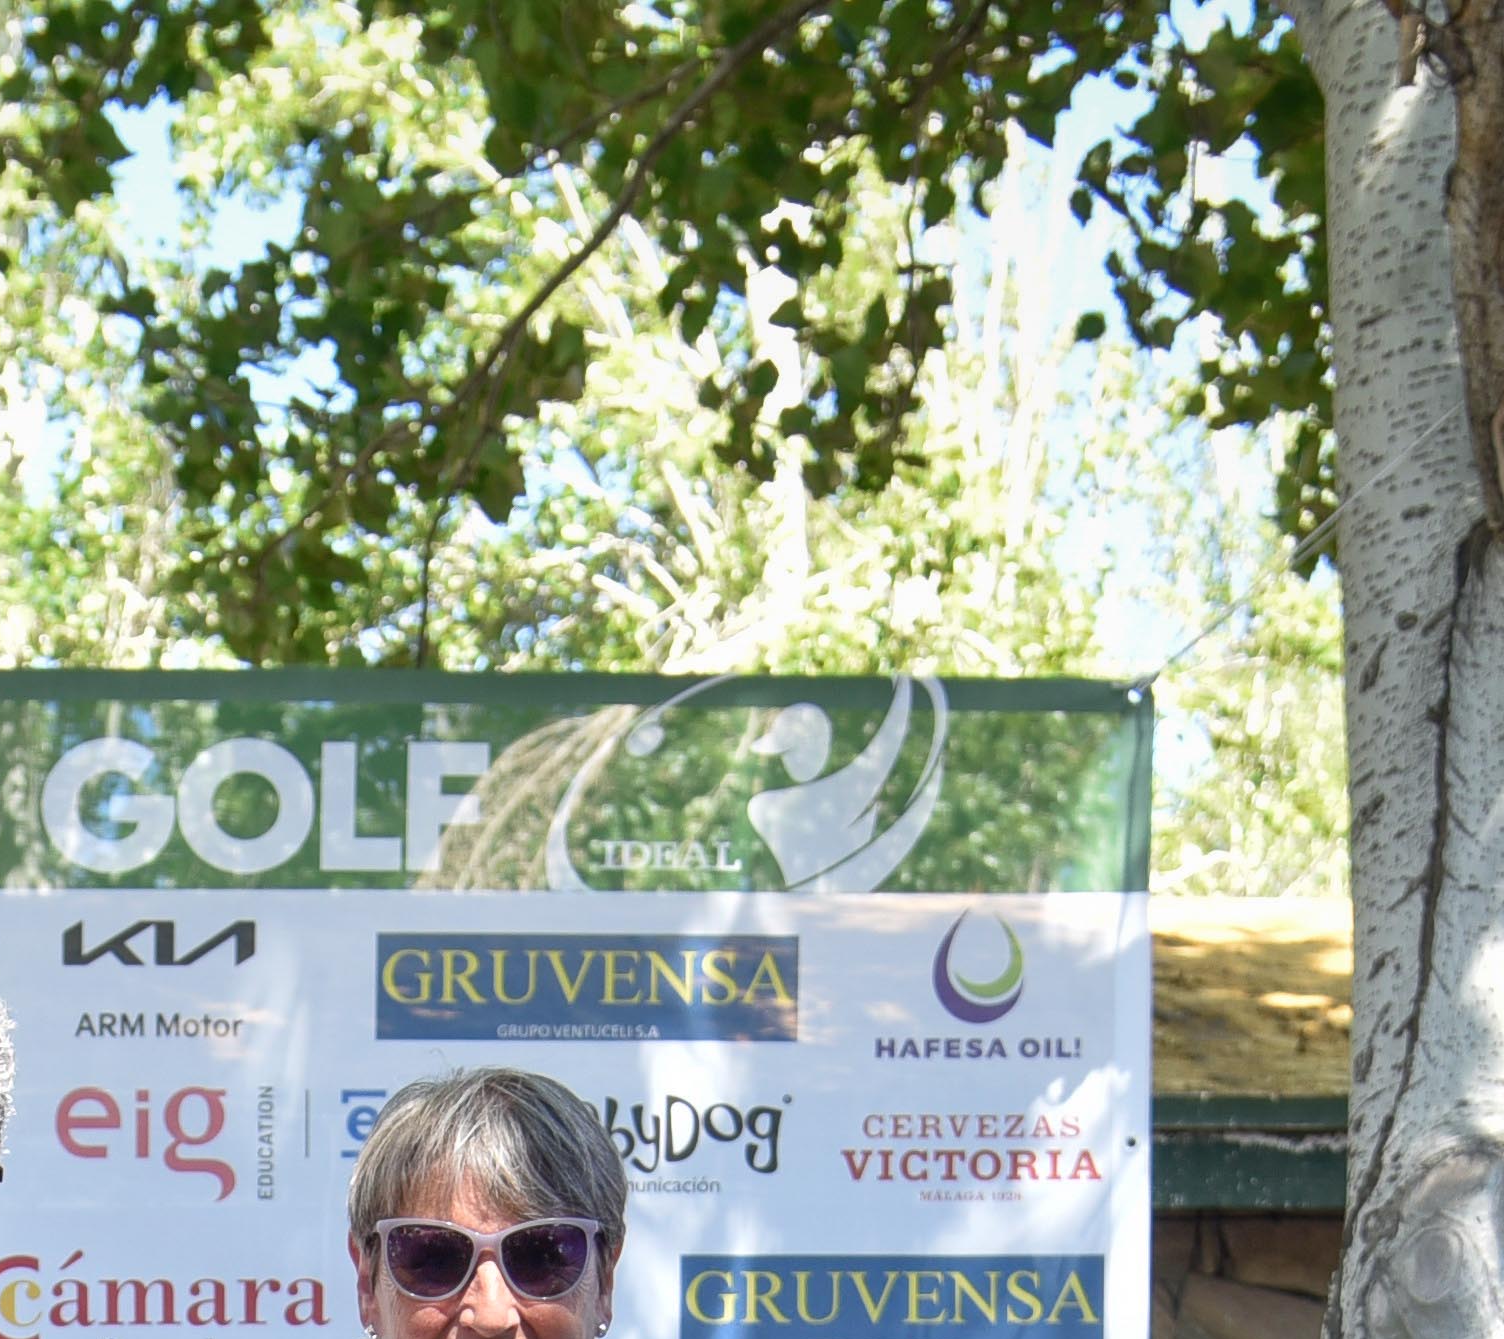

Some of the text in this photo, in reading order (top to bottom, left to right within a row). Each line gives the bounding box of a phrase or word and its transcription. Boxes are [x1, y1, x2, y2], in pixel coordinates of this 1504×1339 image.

[41, 736, 490, 875] GOLF
[597, 840, 742, 873] IDEAL
[62, 919, 256, 966] KIA
[381, 948, 793, 1006] GRUVENSA
[75, 1012, 242, 1039] ARM Motor
[496, 1023, 552, 1039] GRUPO
[874, 1037, 1082, 1059] HAFESA OIL!
[55, 1086, 237, 1202] eig
[256, 1085, 275, 1200] EDUCATION
[584, 1095, 783, 1174] byDog
[862, 1114, 1082, 1139] CERVEZAS
[841, 1149, 1102, 1181] VICTORIA
[685, 1269, 1100, 1325] GRUVENSA
